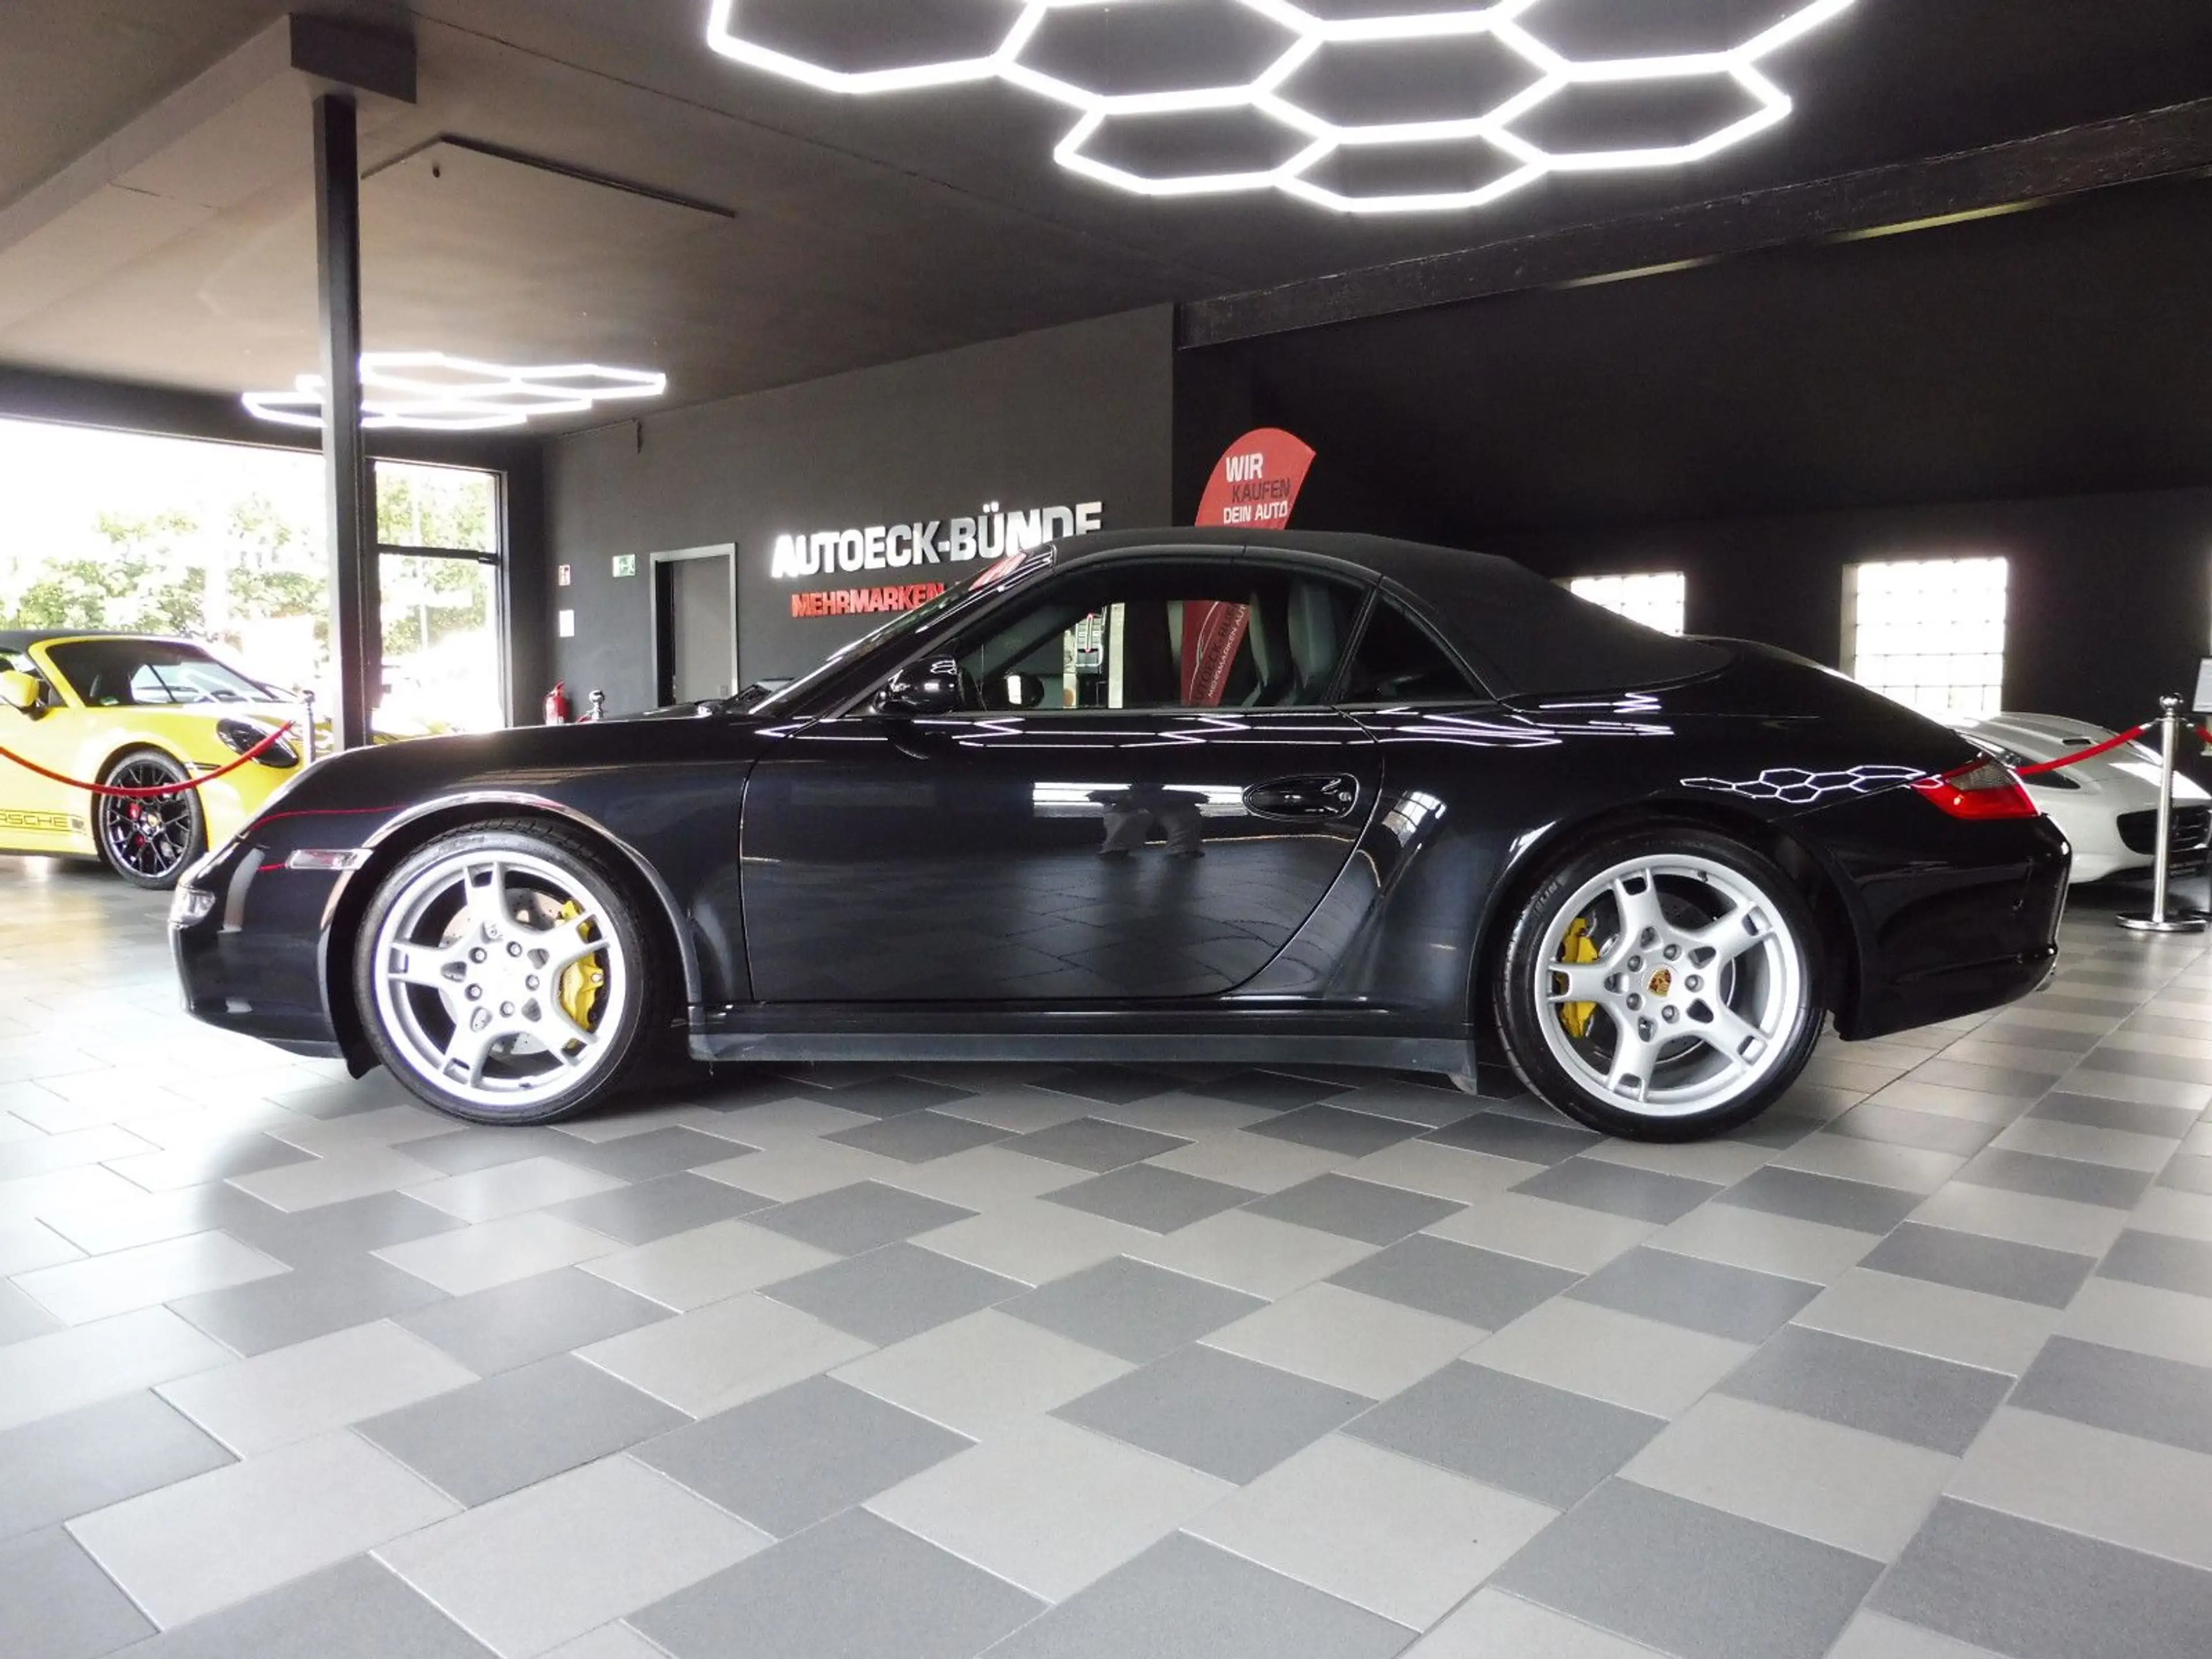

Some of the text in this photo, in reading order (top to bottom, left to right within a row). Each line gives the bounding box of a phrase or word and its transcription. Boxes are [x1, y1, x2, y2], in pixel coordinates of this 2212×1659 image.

[1226, 453, 1263, 483] WIR
[1232, 478, 1291, 503] KAUFEN
[1223, 501, 1288, 524] DEIN AUTO
[771, 501, 1102, 578] AUTOECK-BÜNDE
